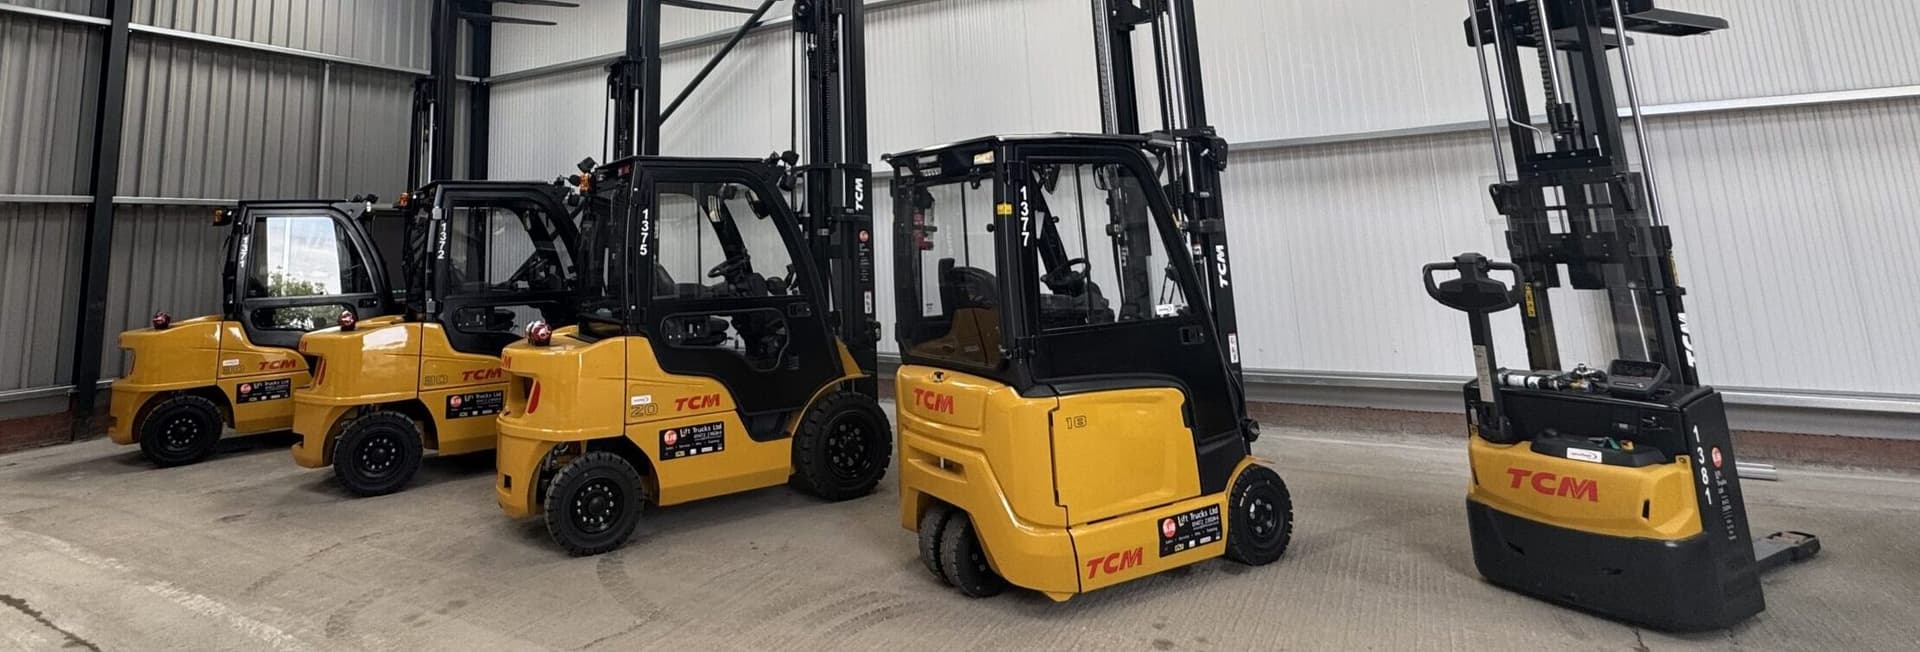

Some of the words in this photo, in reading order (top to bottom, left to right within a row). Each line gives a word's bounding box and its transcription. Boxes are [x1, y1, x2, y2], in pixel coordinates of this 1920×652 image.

[855, 178, 863, 211] TCM
[640, 208, 649, 256] 1375
[1020, 185, 1030, 247] 1377
[437, 222, 447, 259] 1372
[1216, 245, 1229, 288] TCM
[258, 359, 296, 370] TCM
[462, 368, 502, 381] TCM
[675, 394, 720, 411] TCM
[914, 388, 954, 414] TCM
[1065, 415, 1087, 430] 18
[1693, 424, 1712, 505] 1381
[1507, 467, 1598, 503] TCM
[1086, 547, 1143, 579] TCM
